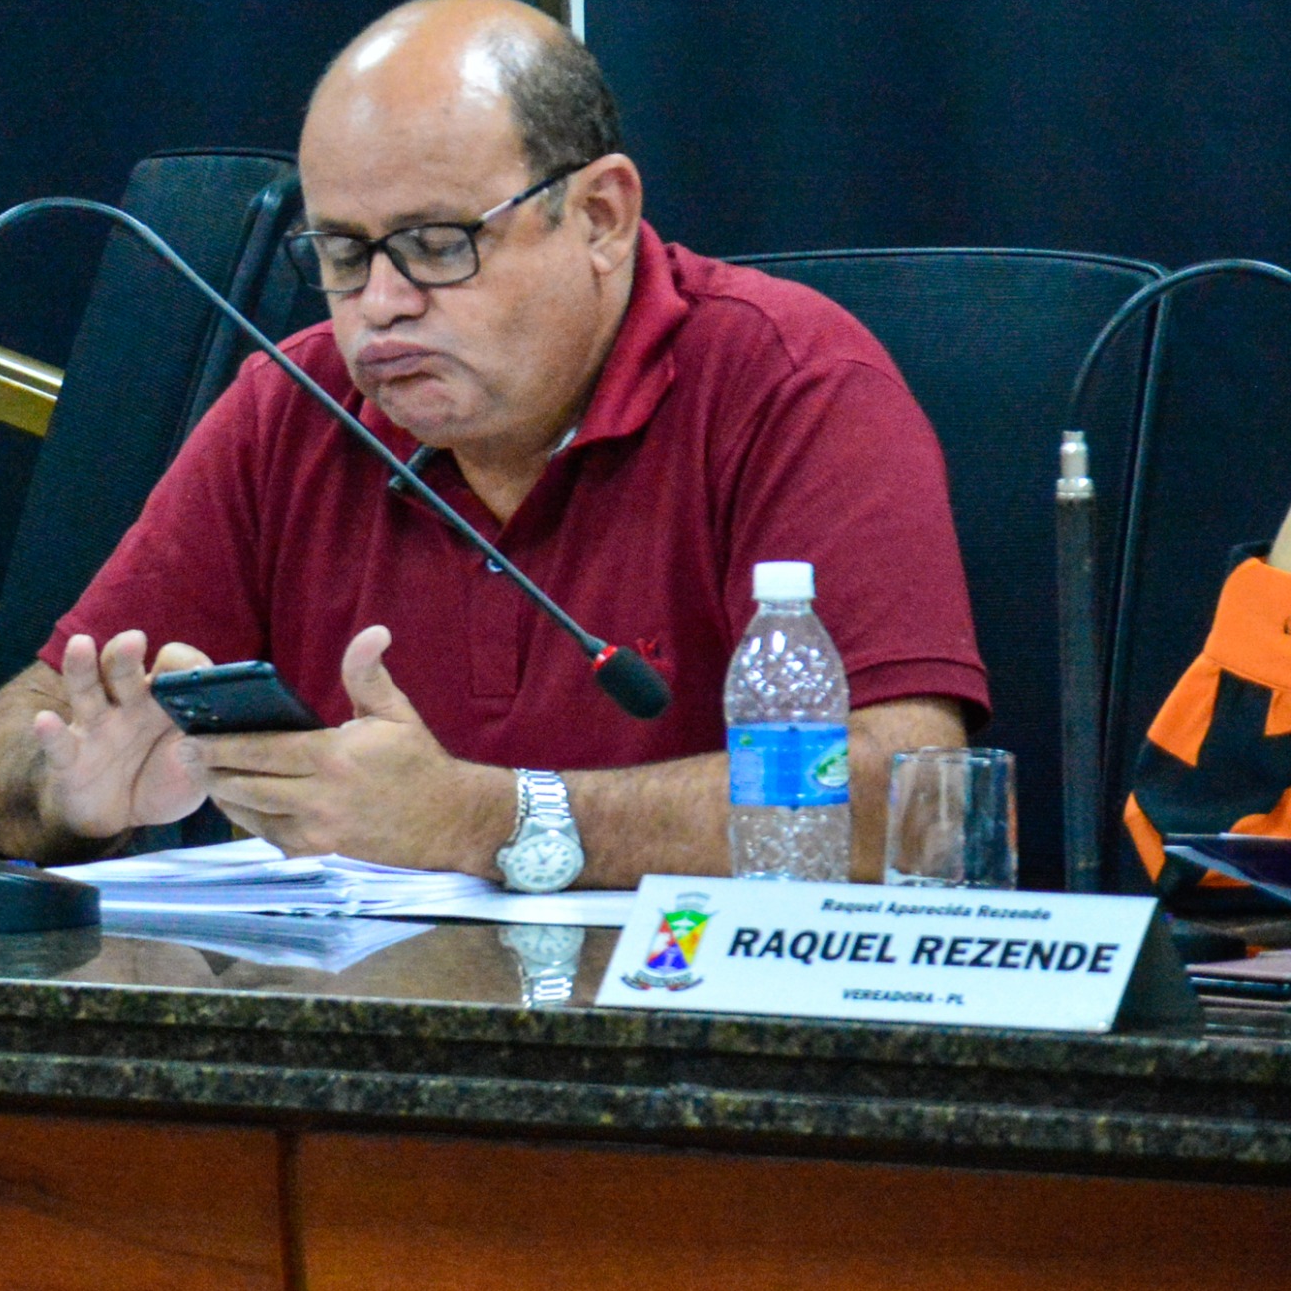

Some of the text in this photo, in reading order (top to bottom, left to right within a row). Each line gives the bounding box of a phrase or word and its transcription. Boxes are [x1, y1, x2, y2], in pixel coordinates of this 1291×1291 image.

[819, 898, 1052, 921] Raquel Aparecida Rezende
[728, 927, 1120, 974] RAQUEL REZENDE
[842, 988, 934, 1004] VEREADORA
[946, 992, 964, 1006] PL
